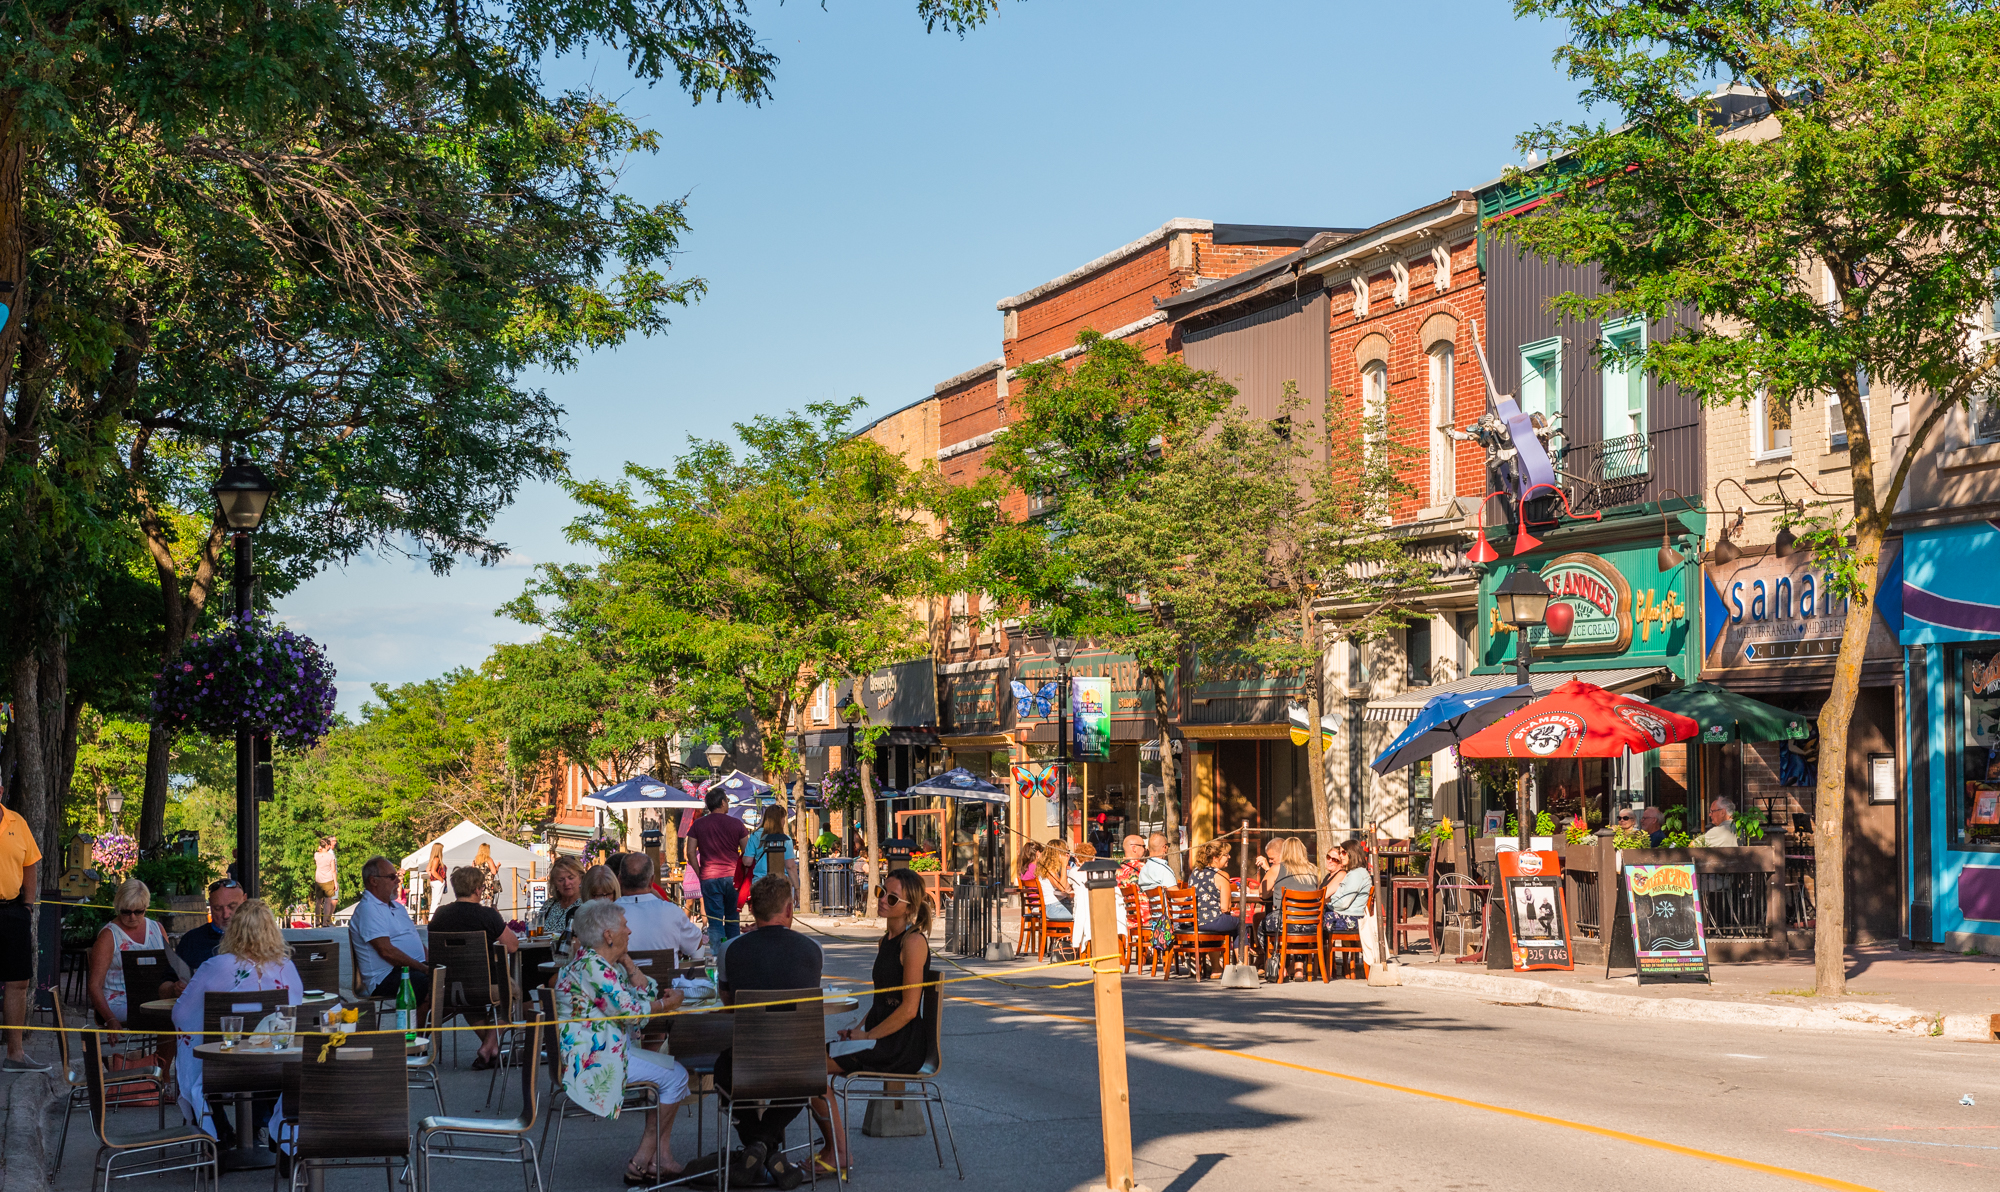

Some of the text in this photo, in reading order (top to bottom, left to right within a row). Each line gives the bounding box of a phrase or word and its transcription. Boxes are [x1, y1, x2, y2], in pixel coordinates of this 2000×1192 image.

[1563, 571, 1614, 617] ANNIE'S
[1574, 624, 1586, 637] ICE
[1587, 622, 1615, 637] CREAM
[1736, 623, 1797, 640] MEDITERRANEAN
[1805, 620, 1833, 635] MIDDLE
[1757, 641, 1837, 656] CUISINE
[869, 670, 898, 694] Brewery Bay
[1514, 715, 1579, 740] ST-AMBROISE
[1076, 732, 1107, 743] DOWNTOWN
[1081, 742, 1102, 751] ORILLIA
[1652, 885, 1667, 894] MUSIC
[1671, 885, 1683, 893] ART
